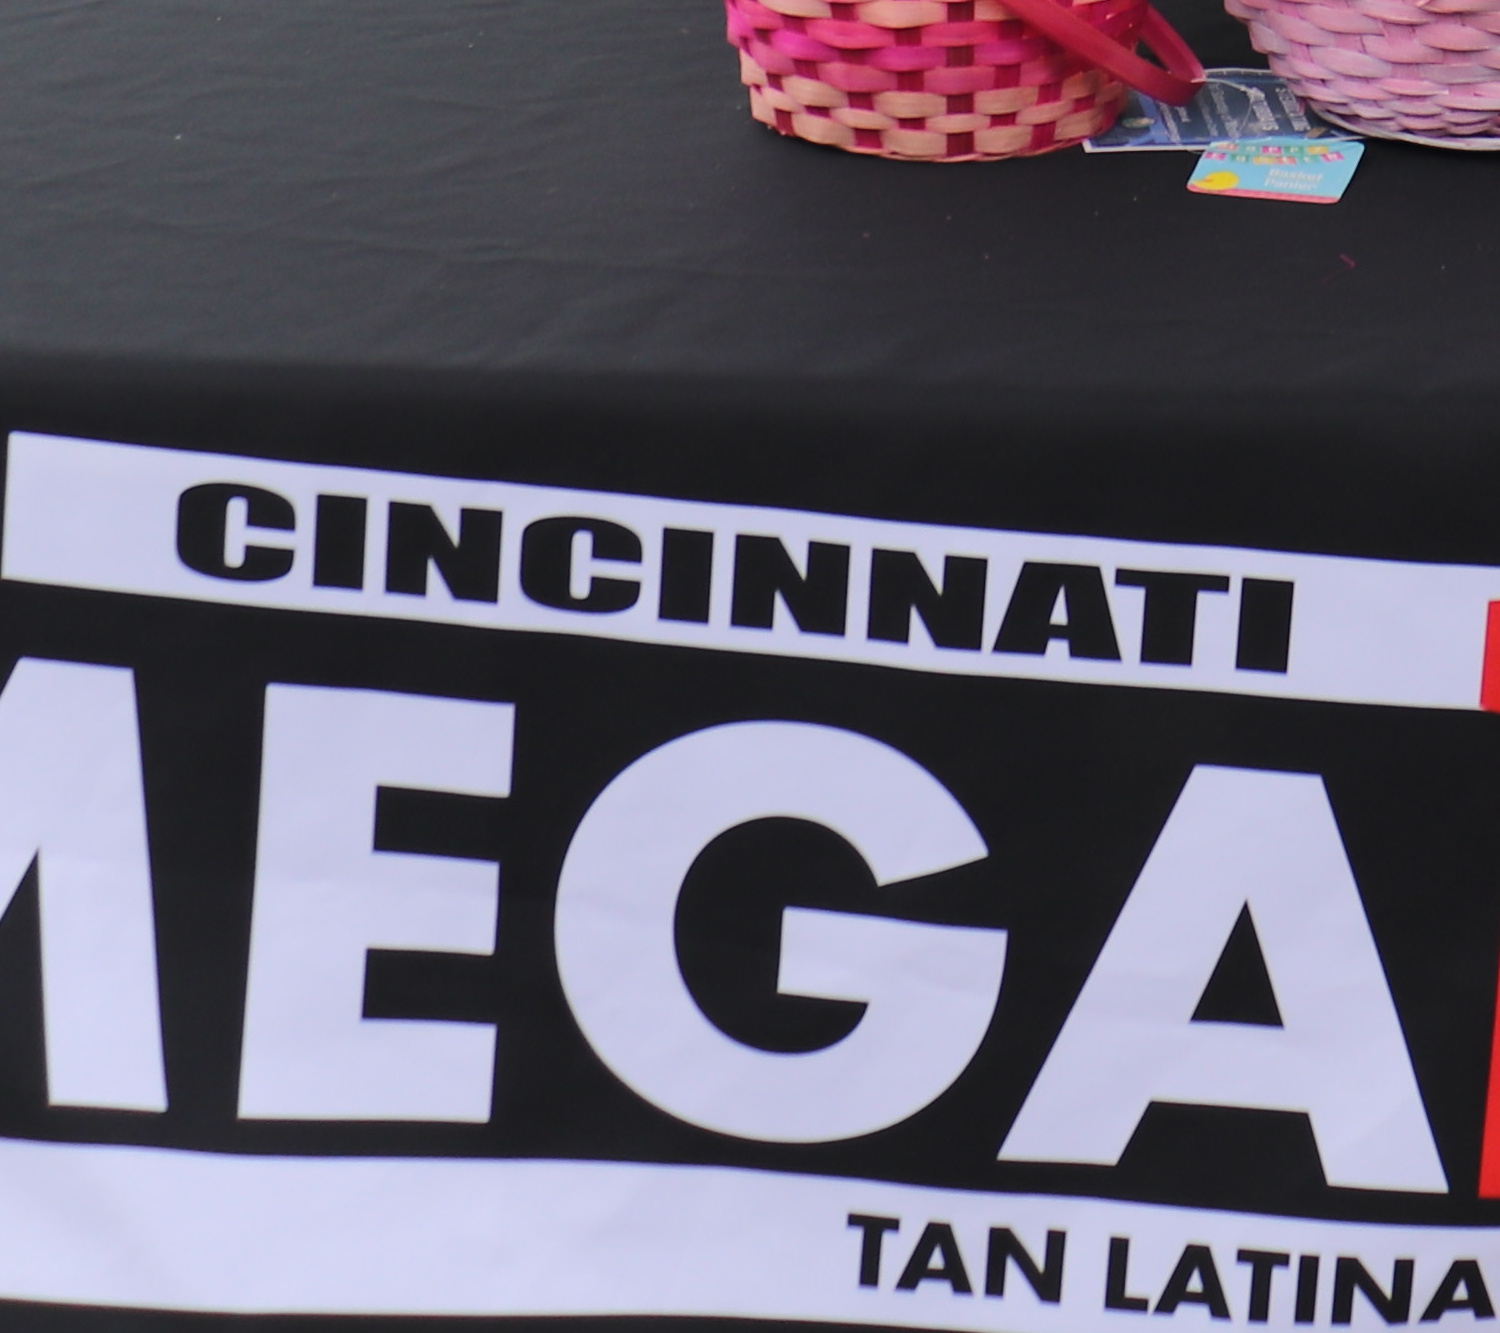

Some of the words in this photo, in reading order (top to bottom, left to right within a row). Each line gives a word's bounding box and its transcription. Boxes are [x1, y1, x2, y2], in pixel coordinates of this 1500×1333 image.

[174, 480, 1296, 676] CINCINNATI
[846, 1213, 1067, 1305] TAN
[1102, 1236, 1497, 1327] LATINA
